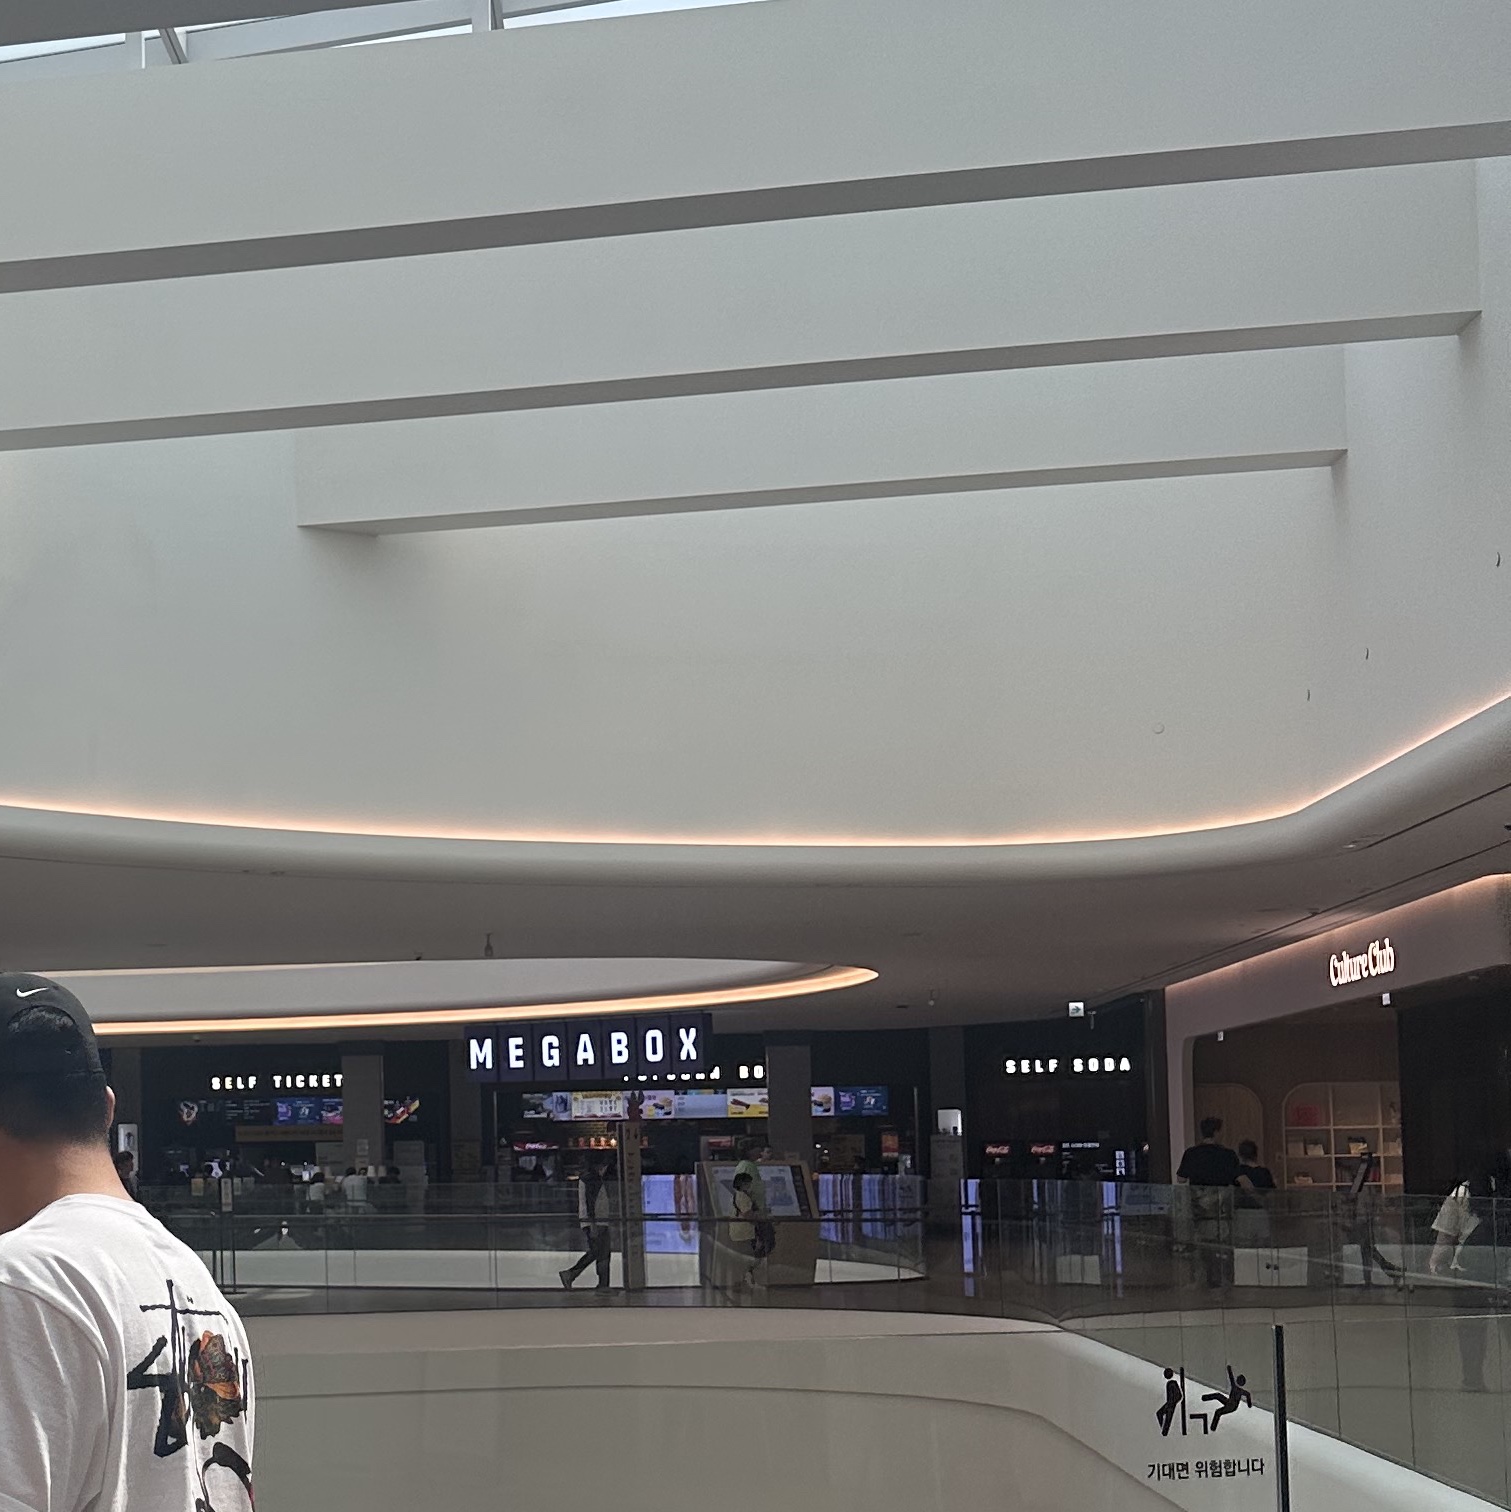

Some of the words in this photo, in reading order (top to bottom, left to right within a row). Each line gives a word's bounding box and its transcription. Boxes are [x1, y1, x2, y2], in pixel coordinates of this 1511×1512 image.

[1330, 950, 1369, 987] Culture
[1368, 937, 1395, 977] Club
[469, 1027, 699, 1070] MEGABOX
[1005, 1058, 1060, 1074] SELF
[1073, 1056, 1132, 1074] SODA
[211, 1075, 258, 1091] SELF
[273, 1073, 344, 1089] TICKET
[1147, 1461, 1189, 1481] 기대면
[1195, 1457, 1265, 1479] 위험합니다
